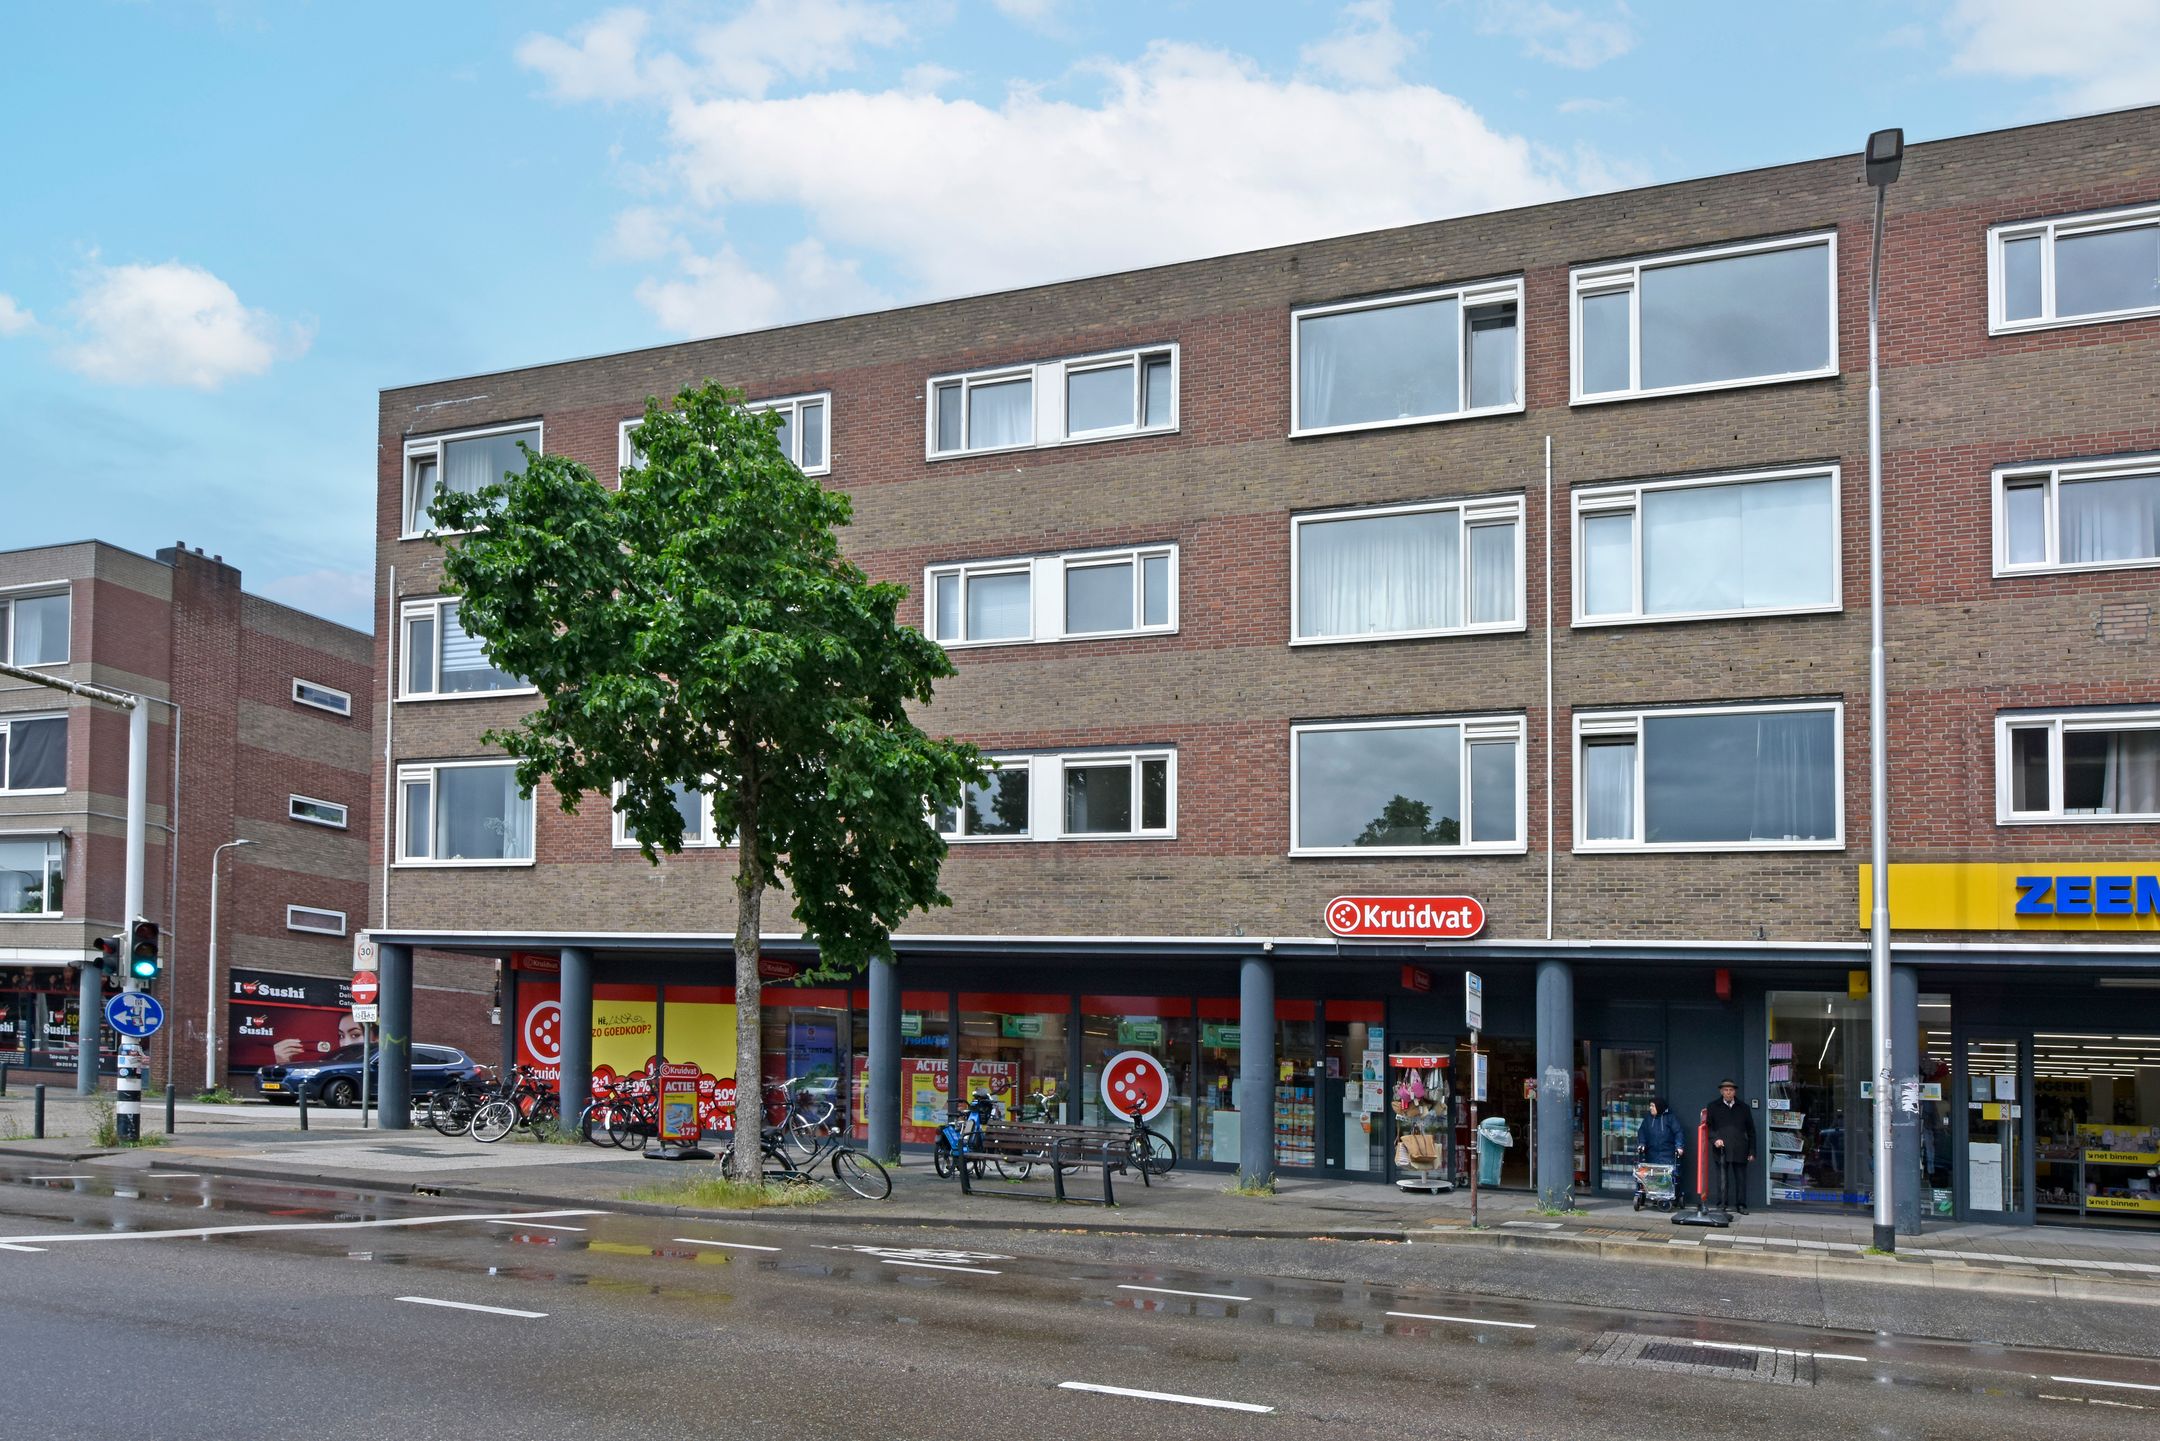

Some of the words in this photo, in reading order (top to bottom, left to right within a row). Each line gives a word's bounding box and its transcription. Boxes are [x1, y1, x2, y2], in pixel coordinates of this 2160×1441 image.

[1364, 904, 1472, 929] Kruidvat
[234, 982, 242, 993] I
[258, 984, 304, 998] Sushi
[246, 1016, 252, 1026] I
[43, 1024, 71, 1035] Sushi
[239, 1026, 274, 1036] Sushi
[592, 1028, 602, 1037] ZO
[604, 1024, 652, 1036] GOEDKOOP?
[670, 1066, 697, 1074] Kruidvat
[971, 1062, 1008, 1074] ACTIE!
[592, 1076, 608, 1088] 2+1
[665, 1081, 695, 1092] ACTIE!
[699, 1080, 716, 1089] 25%
[992, 1078, 1006, 1086] 2+1
